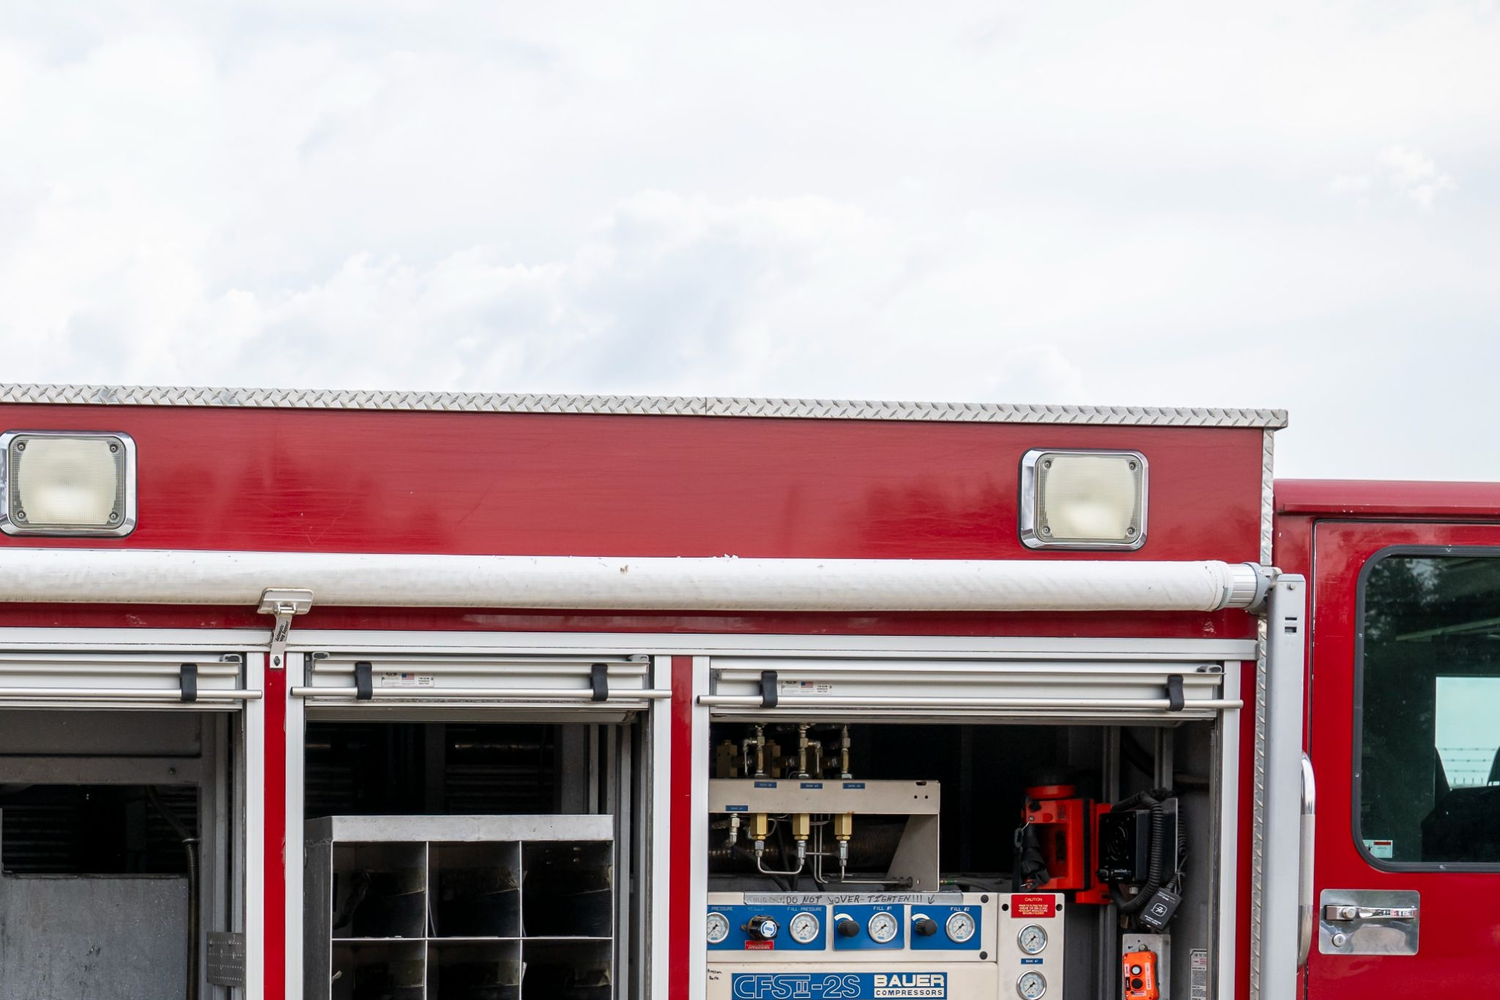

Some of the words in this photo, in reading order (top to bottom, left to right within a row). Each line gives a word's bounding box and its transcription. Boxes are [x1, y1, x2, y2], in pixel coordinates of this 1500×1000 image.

[786, 895, 798, 904] DO
[801, 895, 822, 904] NOT
[874, 974, 944, 988] BAUER
